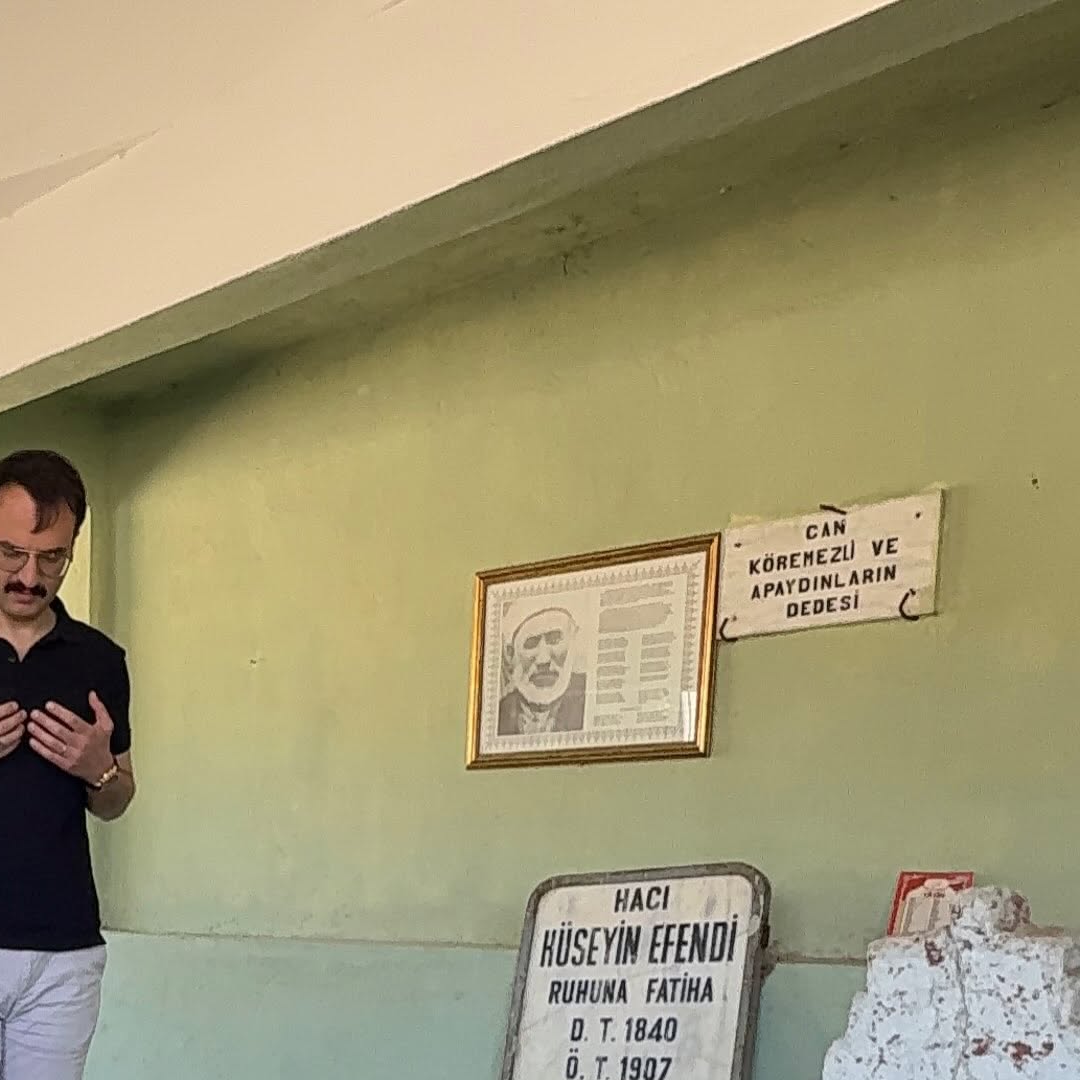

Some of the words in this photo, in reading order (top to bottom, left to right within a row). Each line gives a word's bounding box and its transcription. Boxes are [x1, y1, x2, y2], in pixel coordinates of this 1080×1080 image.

[806, 519, 846, 541] CAN
[749, 540, 855, 575] KÖREMEZLİ
[872, 537, 899, 557] VE
[751, 564, 897, 600] APAYDINLARIN
[787, 590, 859, 618] DEDESİ
[614, 885, 670, 913] HACI
[540, 919, 641, 967] HÜSEYİN
[648, 914, 738, 965] EFENDİ
[548, 979, 628, 1004] RUHUNA
[646, 972, 713, 1004] FATİHA
[625, 1017, 678, 1042] 1840
